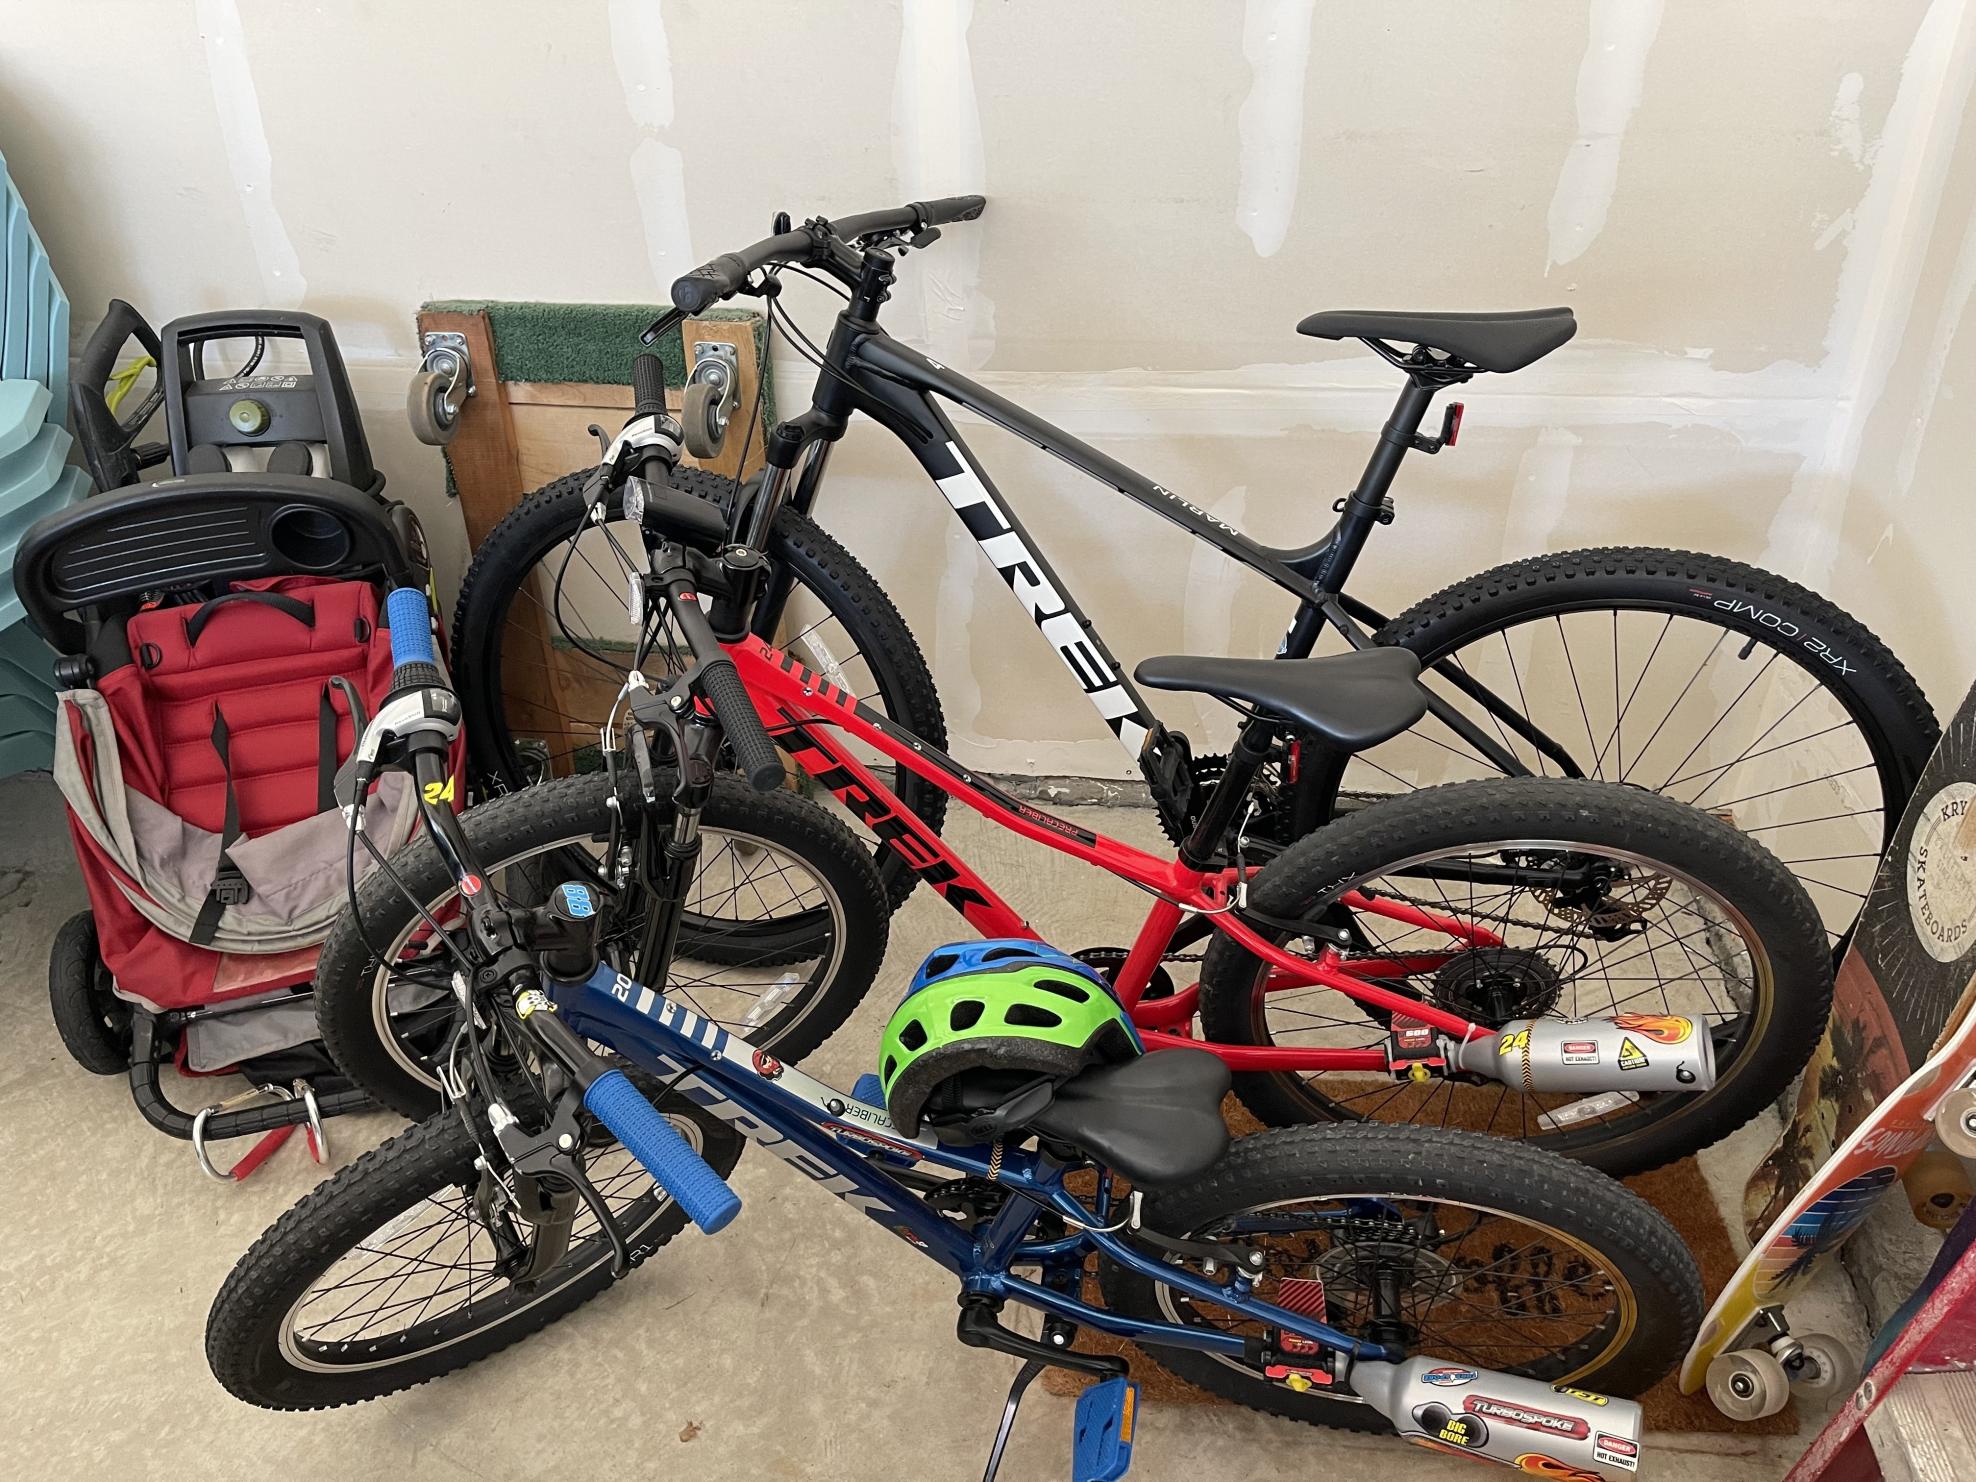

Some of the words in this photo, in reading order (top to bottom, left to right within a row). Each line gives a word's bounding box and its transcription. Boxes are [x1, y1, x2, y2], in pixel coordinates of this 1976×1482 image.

[926, 357, 945, 370] 4
[1152, 485, 1239, 536] MARLIN
[934, 440, 1162, 765] TREK
[1713, 599, 1800, 638] COMP
[759, 645, 775, 662] 2
[1803, 636, 1858, 677] XR2
[423, 775, 456, 805] 24
[769, 705, 994, 915] TREK
[1018, 803, 1079, 836] PRECALIBER
[1940, 800, 1968, 822] KRY
[561, 884, 597, 918] 88
[1916, 846, 1968, 944] SKATEBOARDS
[611, 972, 633, 1003] 20
[1498, 1030, 1530, 1056] 24
[844, 1103, 896, 1130] CALIBER
[655, 1053, 897, 1217] TREK
[630, 1244, 654, 1263] R1
[1446, 1419, 1467, 1435] BIG
[1472, 1400, 1575, 1433] TURBOSPOKE
[1438, 1430, 1471, 1447] BORE
[1603, 1439, 1632, 1453] DANGER
[1608, 1454, 1637, 1470] EXHAUST!
